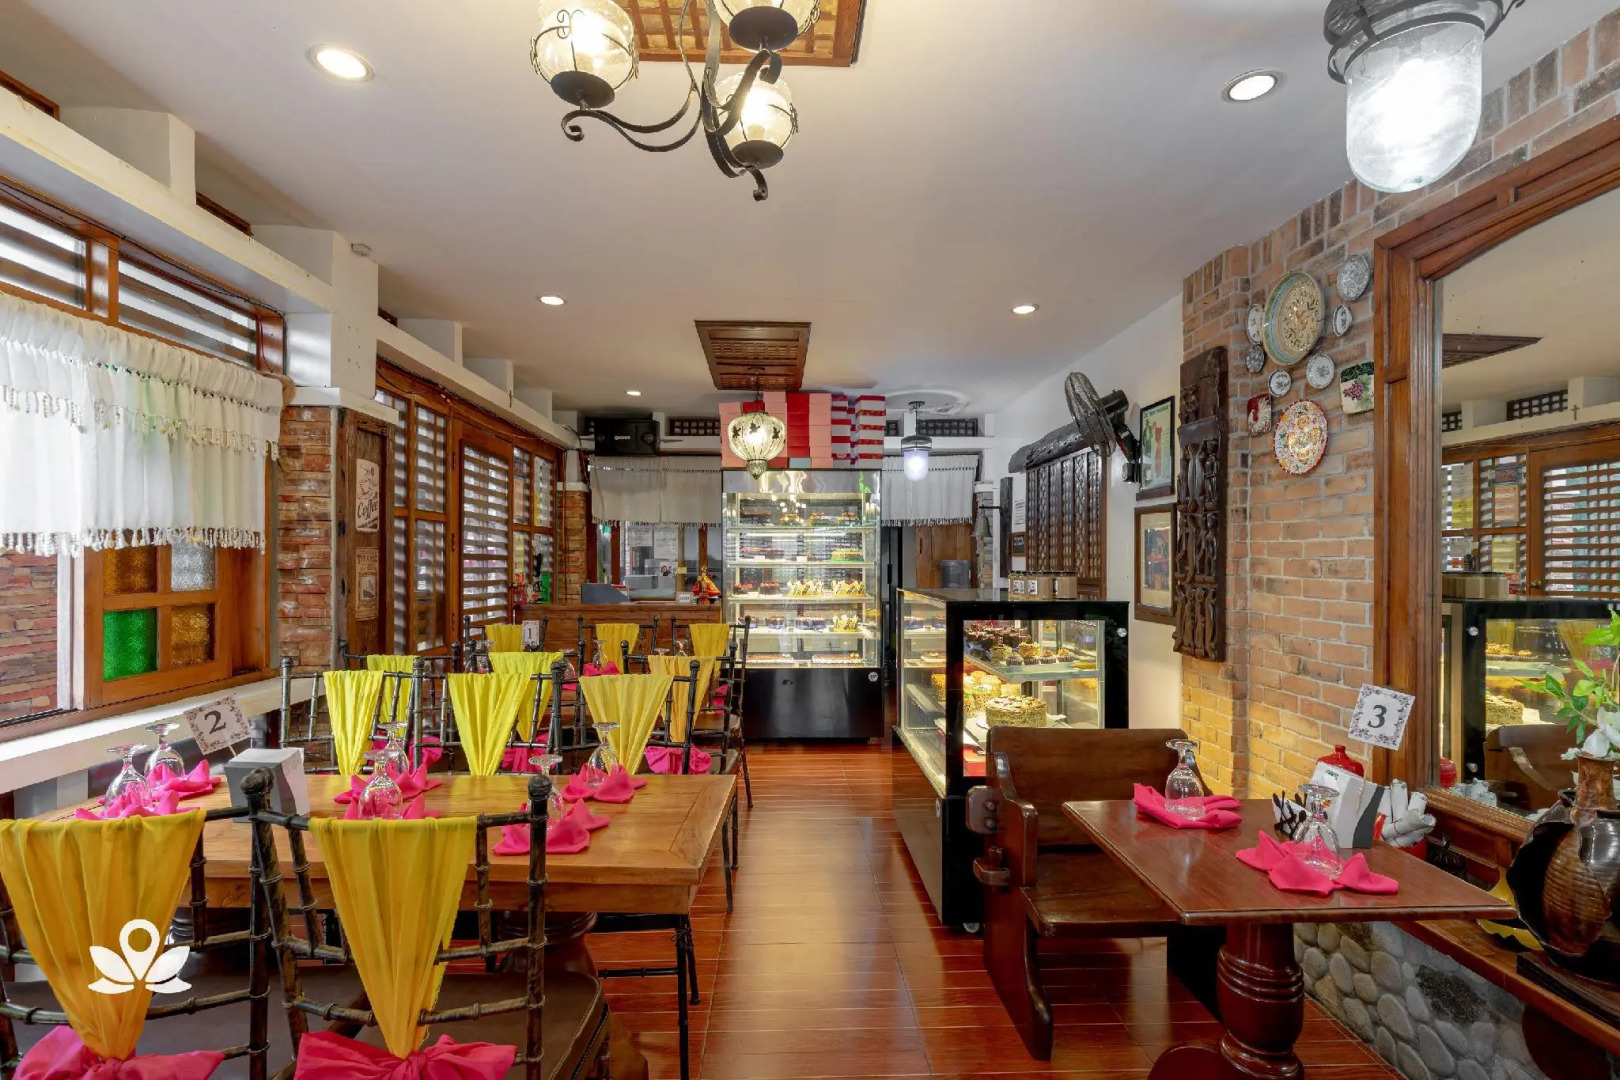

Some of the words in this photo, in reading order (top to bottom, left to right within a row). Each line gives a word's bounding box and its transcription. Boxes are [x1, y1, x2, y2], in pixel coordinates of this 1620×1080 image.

[357, 499, 379, 519] Coffee
[204, 710, 226, 734] 2
[1367, 704, 1387, 728] 3
